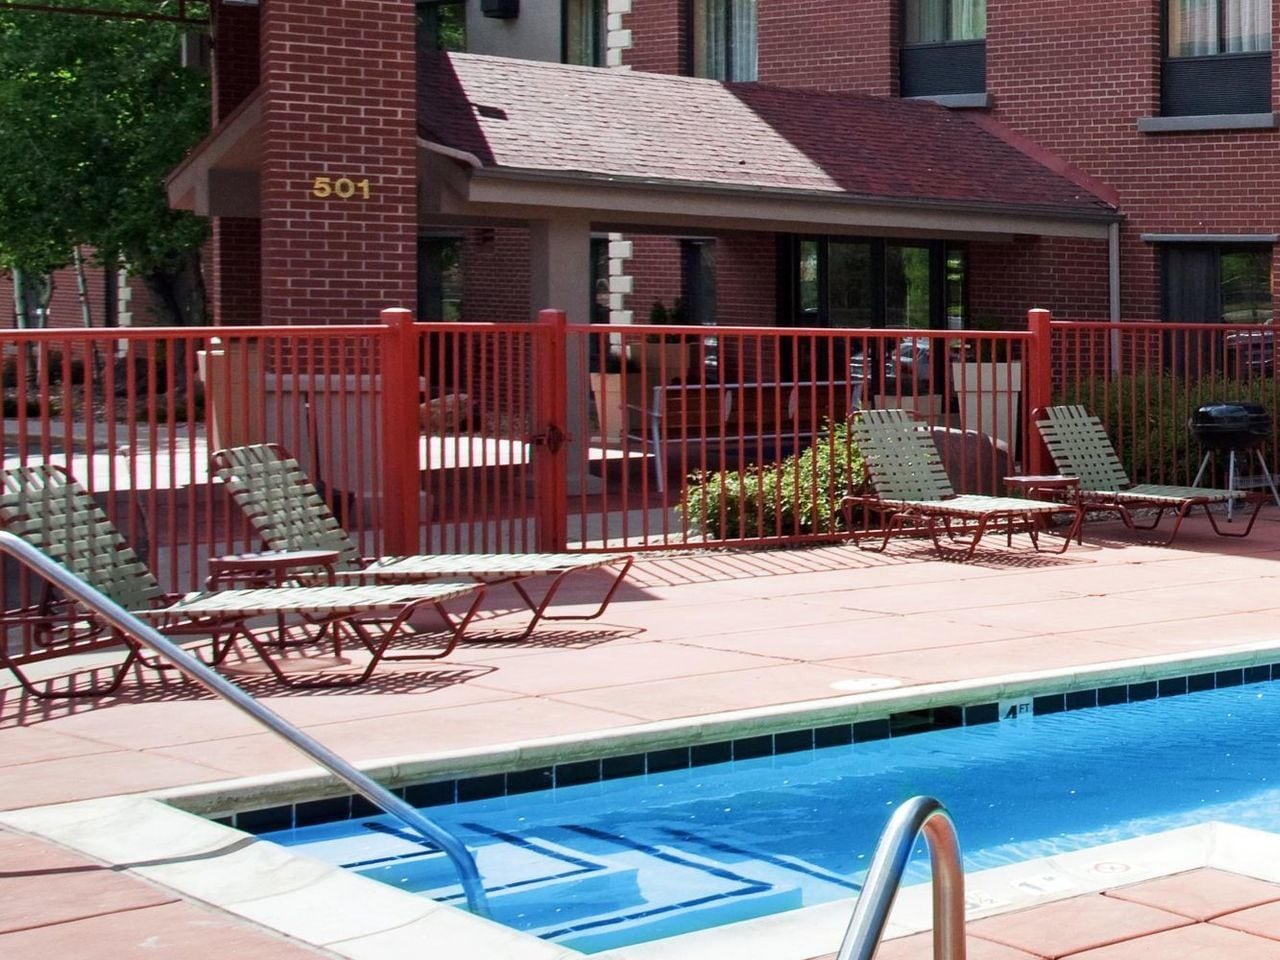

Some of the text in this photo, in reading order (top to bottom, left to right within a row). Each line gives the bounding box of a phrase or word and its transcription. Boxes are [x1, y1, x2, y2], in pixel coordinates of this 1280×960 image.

[313, 177, 370, 199] 501
[1003, 703, 1030, 719] 4 FT
